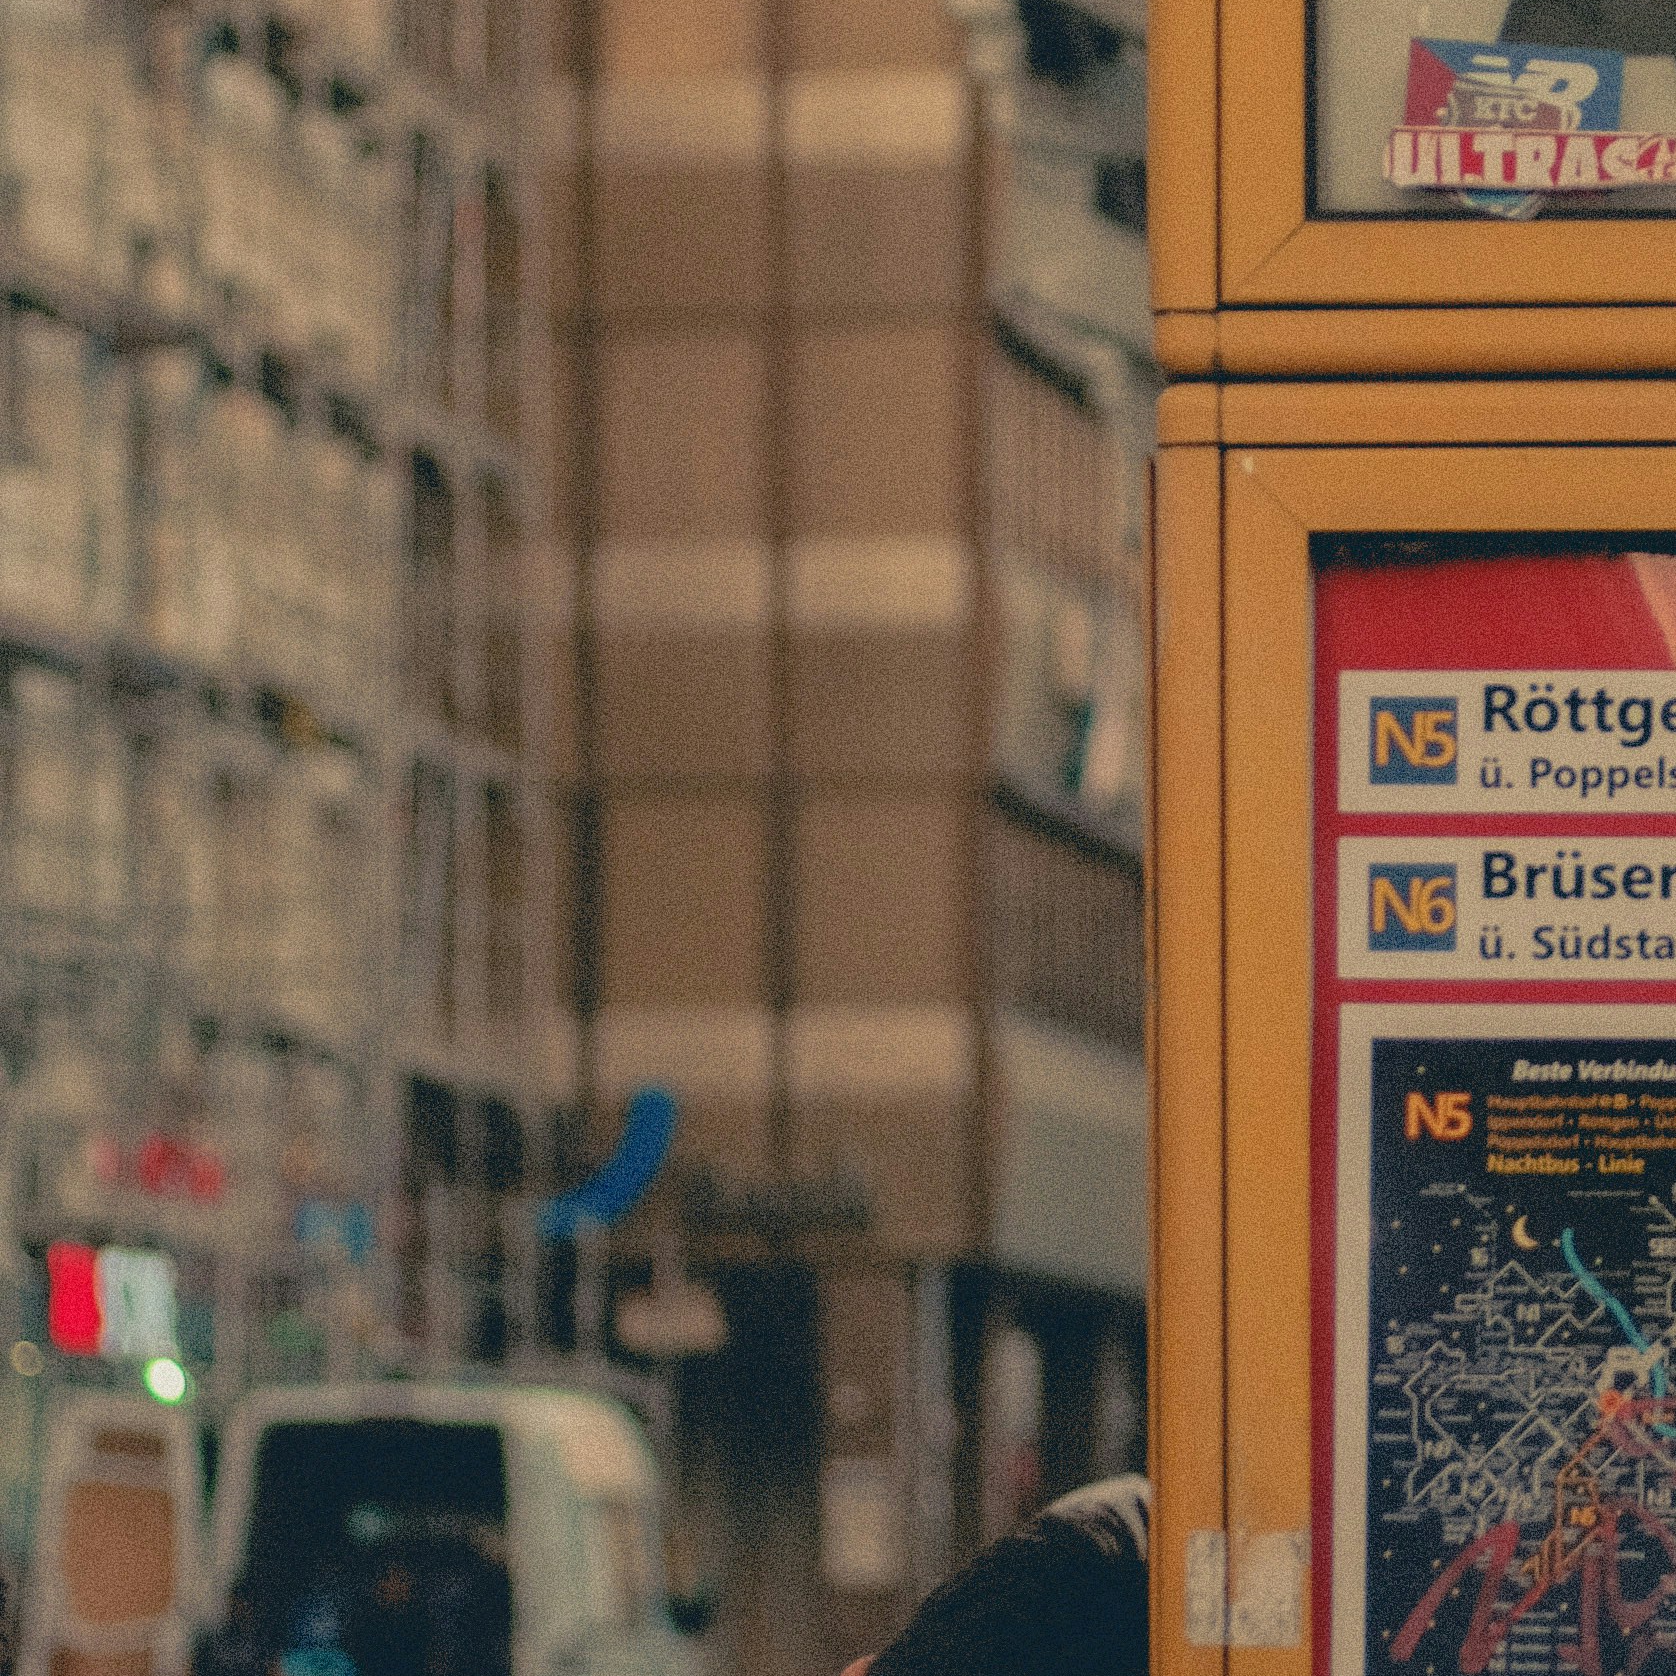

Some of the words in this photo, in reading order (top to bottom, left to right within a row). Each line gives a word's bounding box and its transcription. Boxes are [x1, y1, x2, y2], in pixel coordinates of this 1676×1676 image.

[1373, 710, 1457, 769] N5
[1480, 758, 1516, 790] ü.
[1371, 876, 1457, 936] N6
[1480, 930, 1516, 962] ü.
[1511, 1060, 1572, 1082] Beste
[1405, 1092, 1473, 1141] N5
[1487, 1153, 1580, 1174] Nachtbus
[1597, 1153, 1646, 1174] Linie
